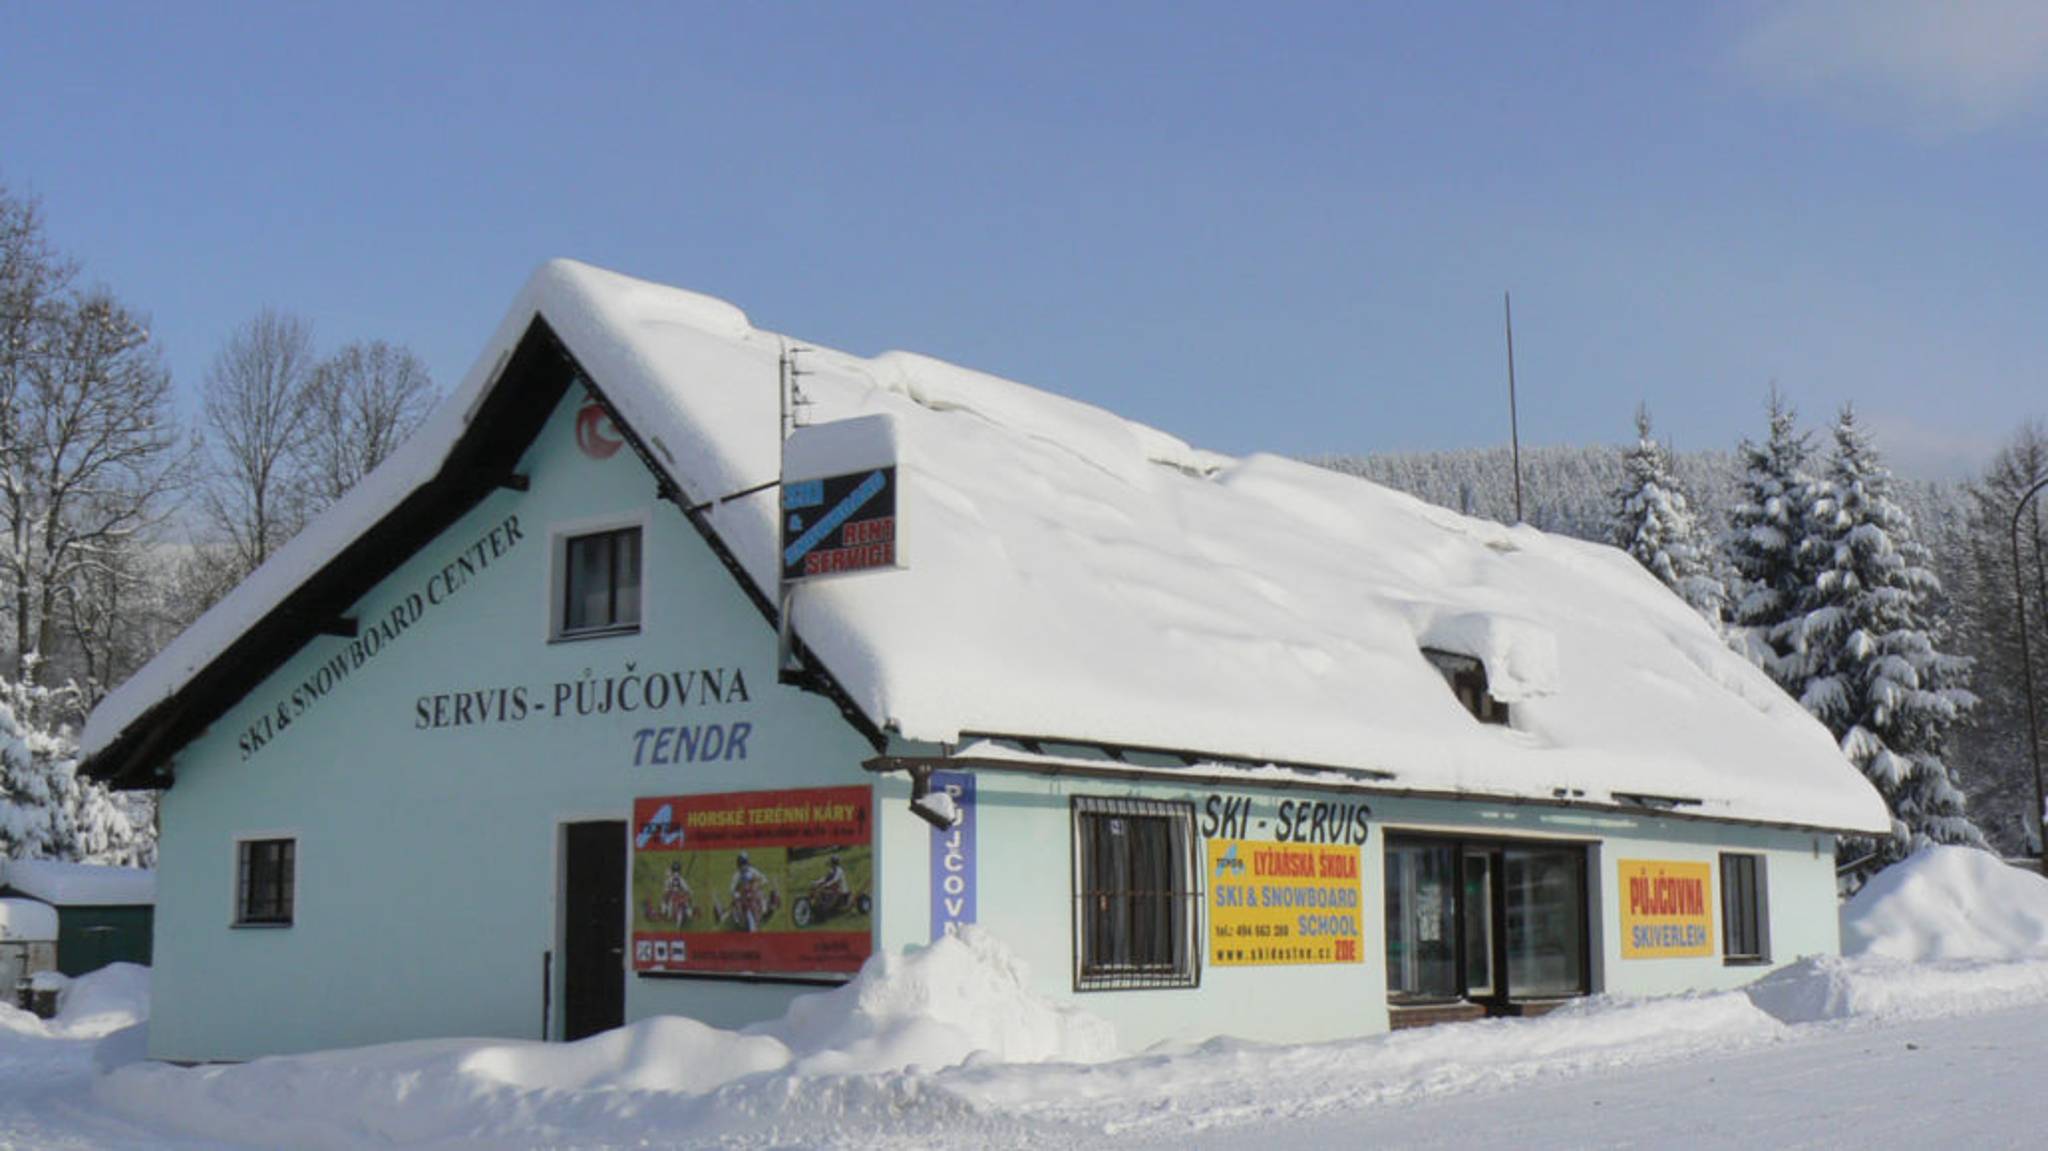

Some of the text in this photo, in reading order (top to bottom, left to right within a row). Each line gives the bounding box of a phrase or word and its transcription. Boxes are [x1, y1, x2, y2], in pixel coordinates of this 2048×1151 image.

[804, 543, 894, 575] SERVICE
[238, 514, 525, 761] SKI & SNOWBOARD CENTER
[415, 686, 528, 730] SERVIS
[554, 662, 750, 717] PŮJČOVNA
[633, 722, 752, 767] TENDR
[1202, 794, 1251, 840] SKI
[1275, 800, 1371, 845] SERVIS
[1215, 884, 1358, 908] SKI & SNOWBOARD
[1630, 866, 1704, 916] PŮJČOVNA
[1298, 914, 1358, 937] SCHOOL
